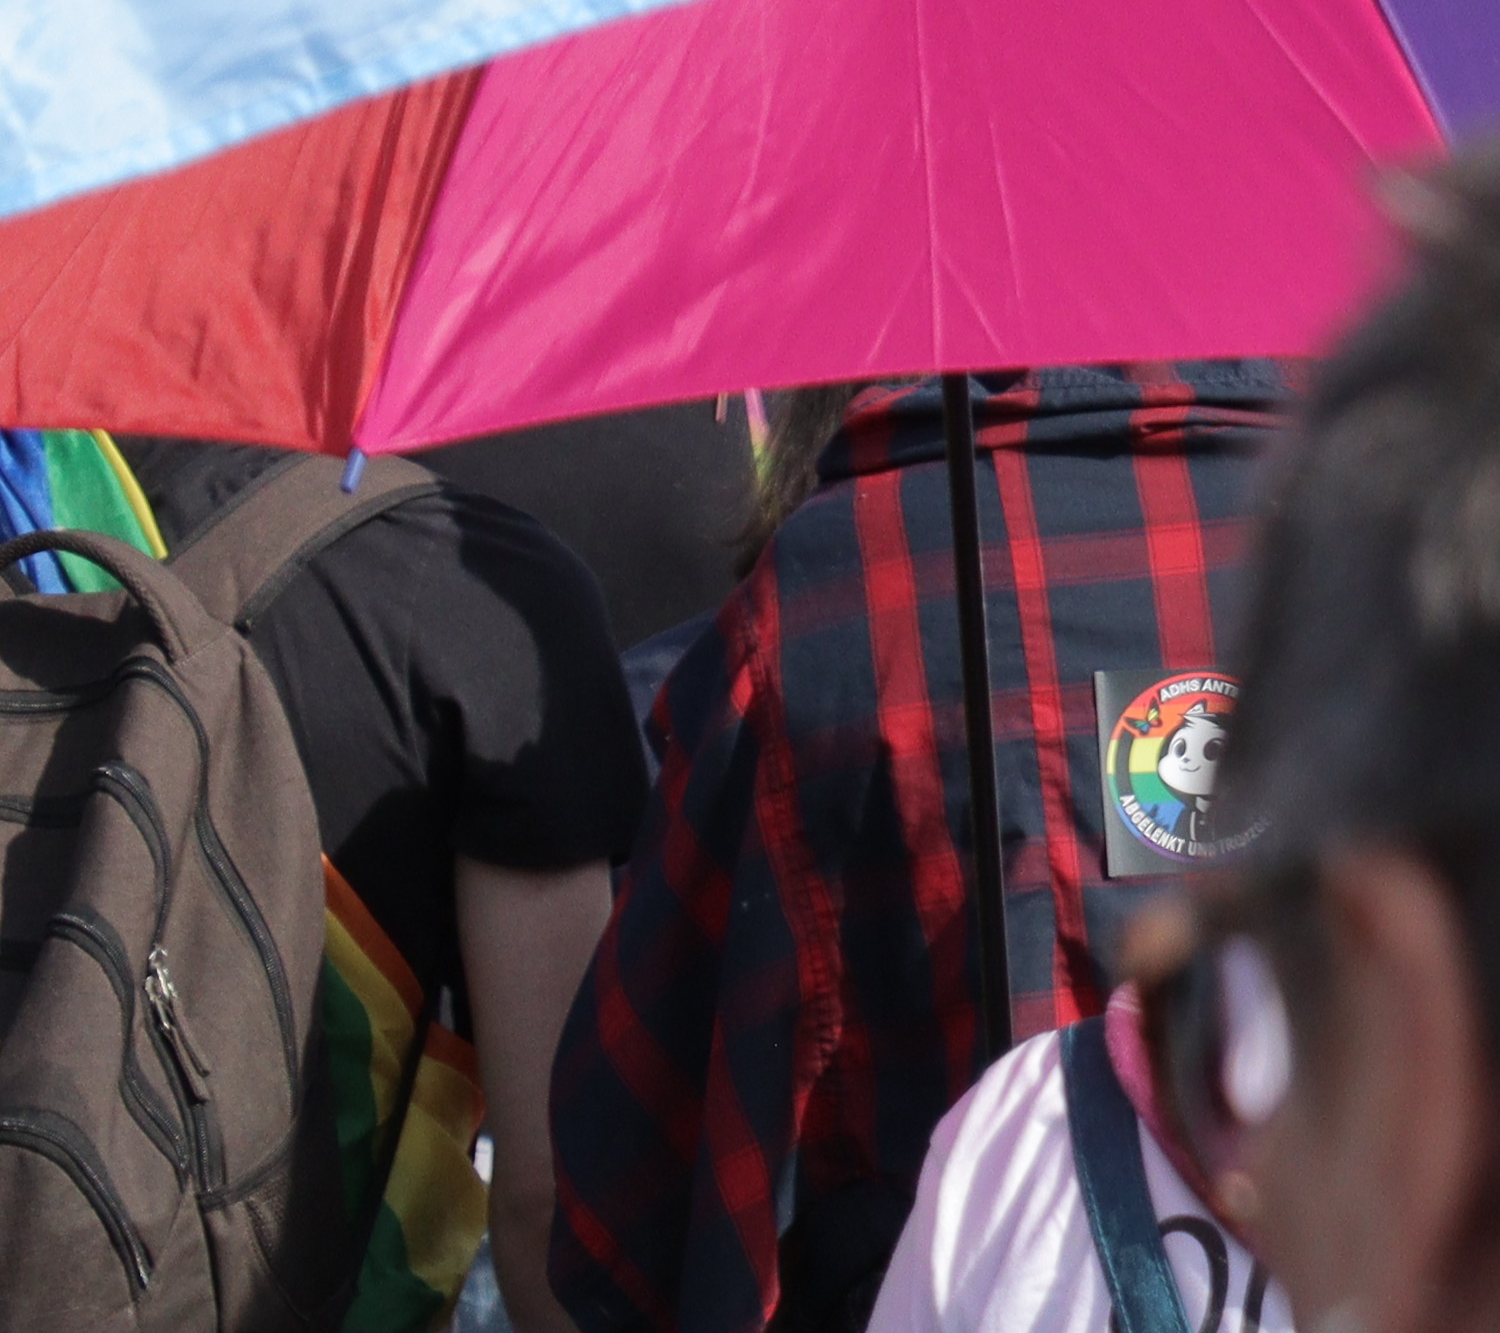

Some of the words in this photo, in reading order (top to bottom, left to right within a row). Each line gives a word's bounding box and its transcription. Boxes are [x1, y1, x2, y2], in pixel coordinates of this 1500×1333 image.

[1159, 677, 1201, 703] ADHS
[1119, 794, 1186, 854] ABGELENKT
[1187, 840, 1217, 858] UND
